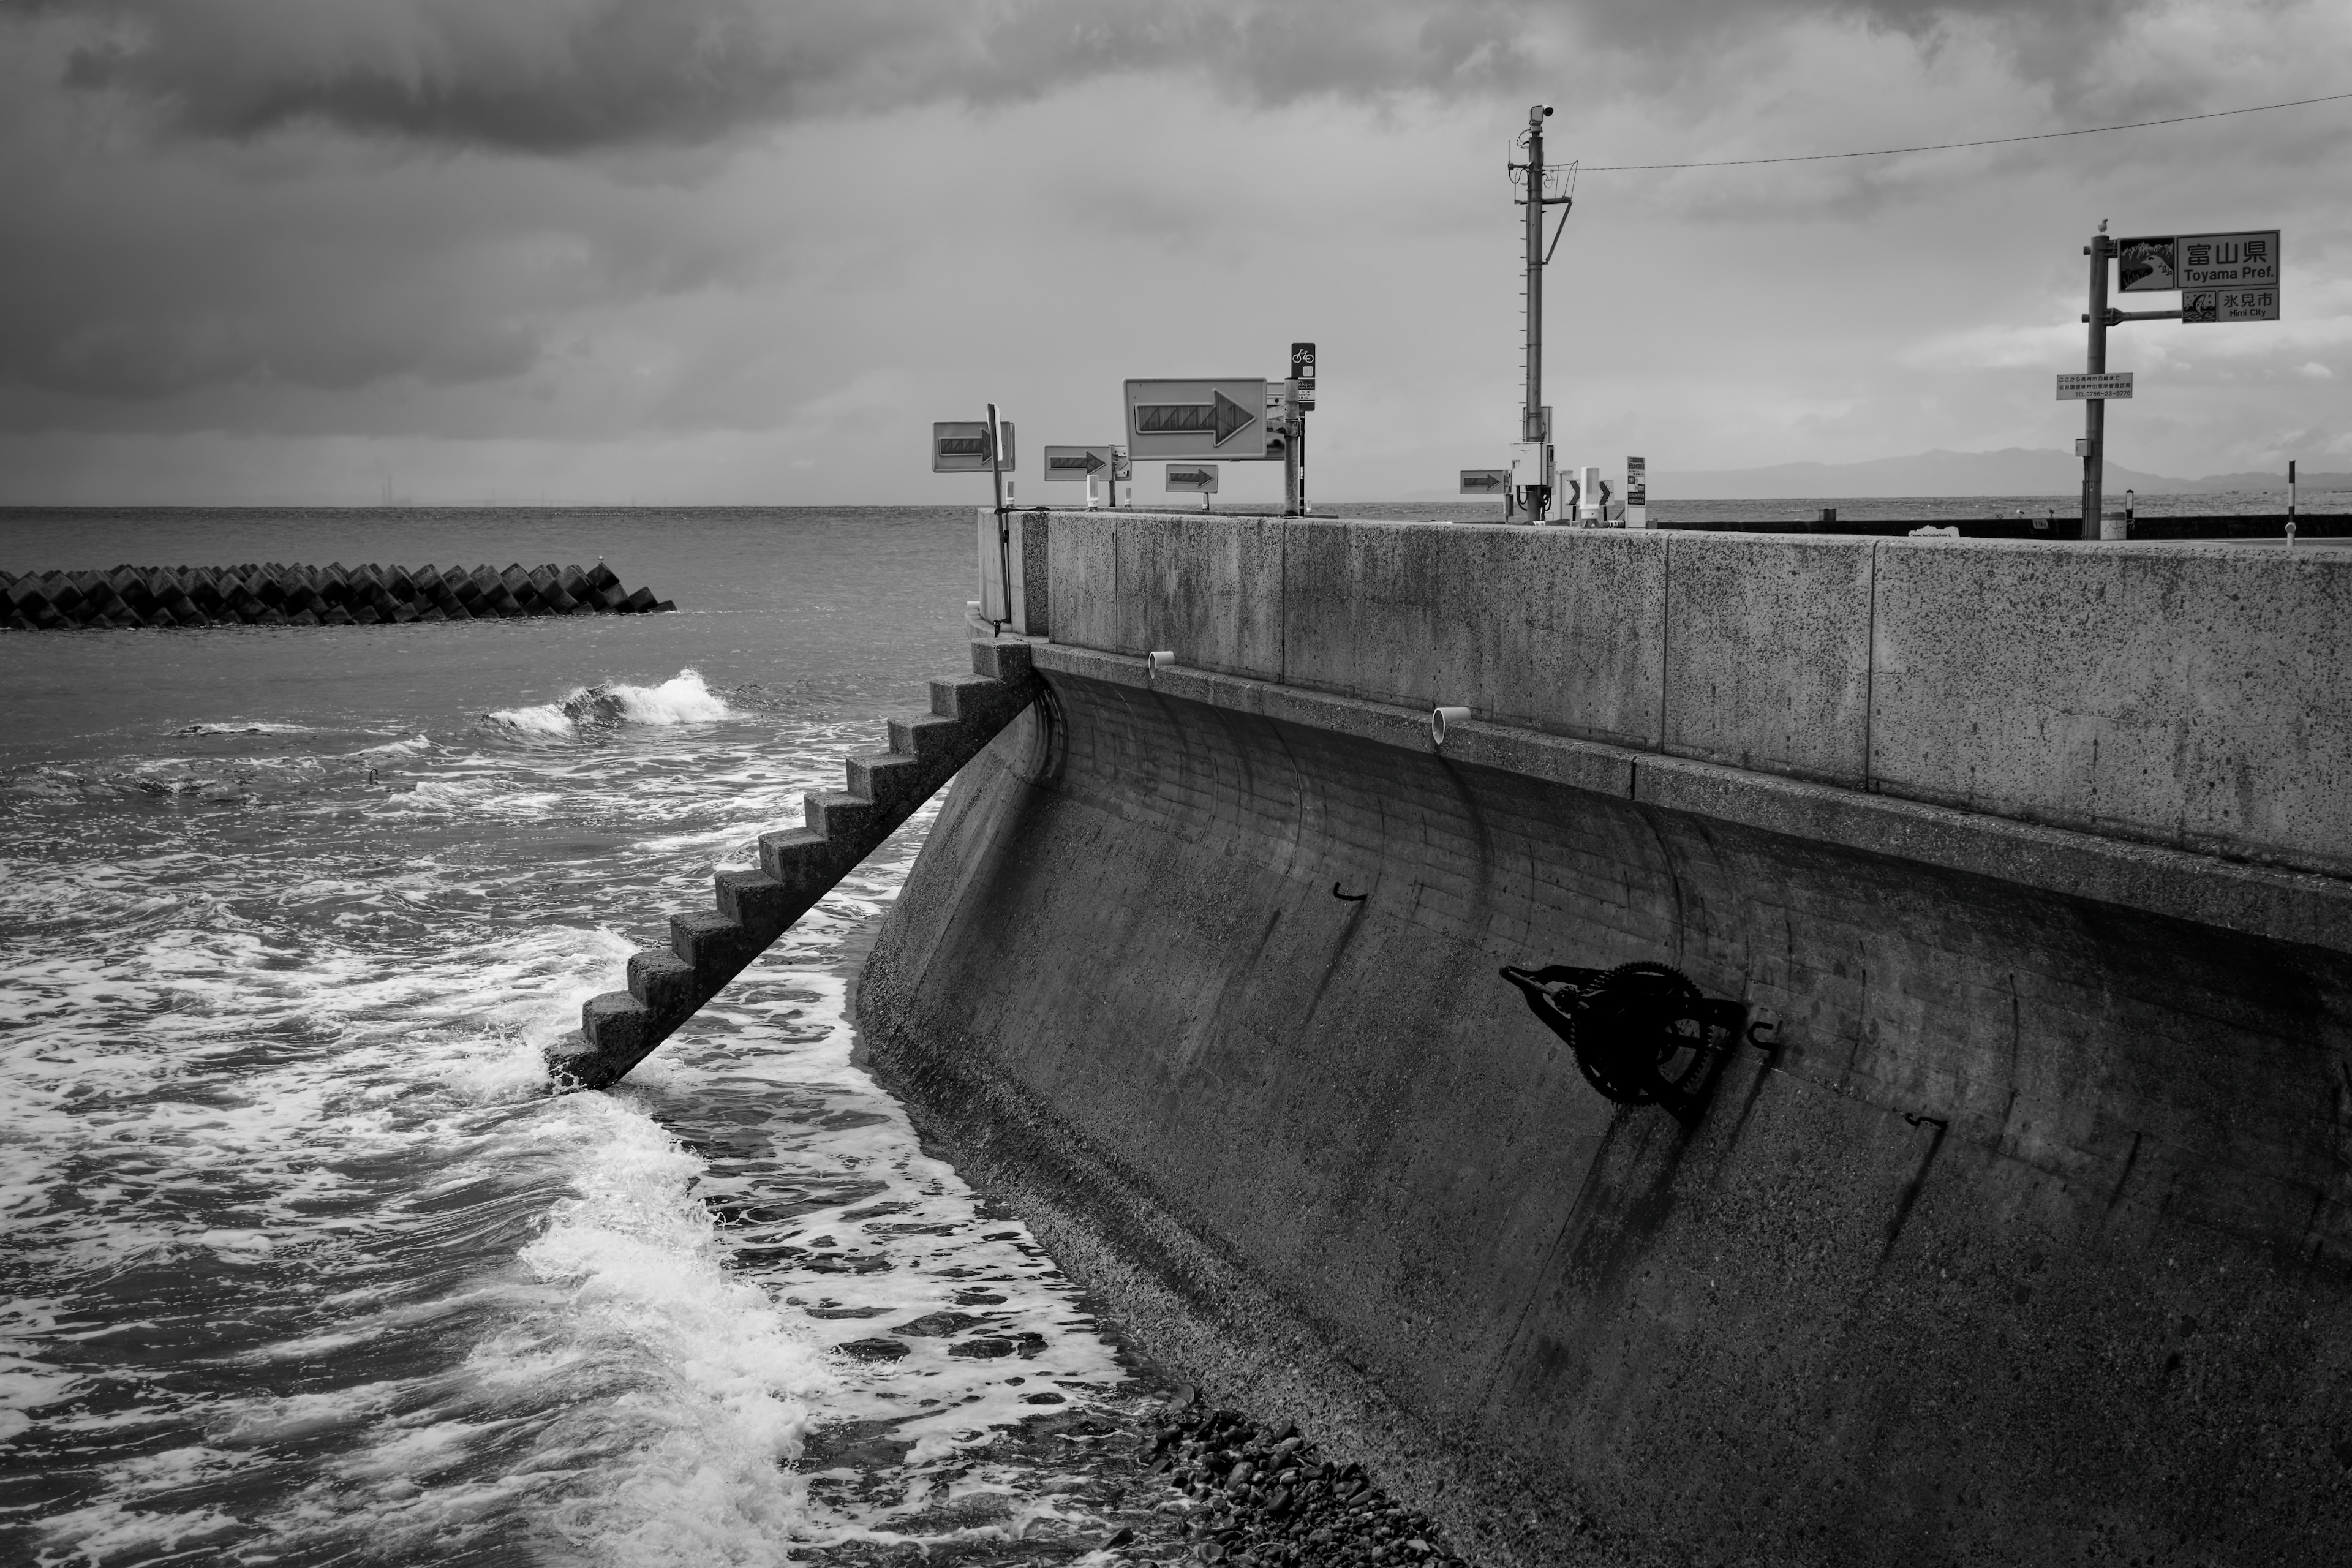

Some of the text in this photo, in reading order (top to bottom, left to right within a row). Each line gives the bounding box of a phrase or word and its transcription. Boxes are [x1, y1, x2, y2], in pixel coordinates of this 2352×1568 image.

[2187, 241, 2267, 266] 富山県
[2184, 266, 2274, 283] Toyama Pref.
[2224, 293, 2272, 307] 氷見市
[2250, 308, 2266, 317] City
